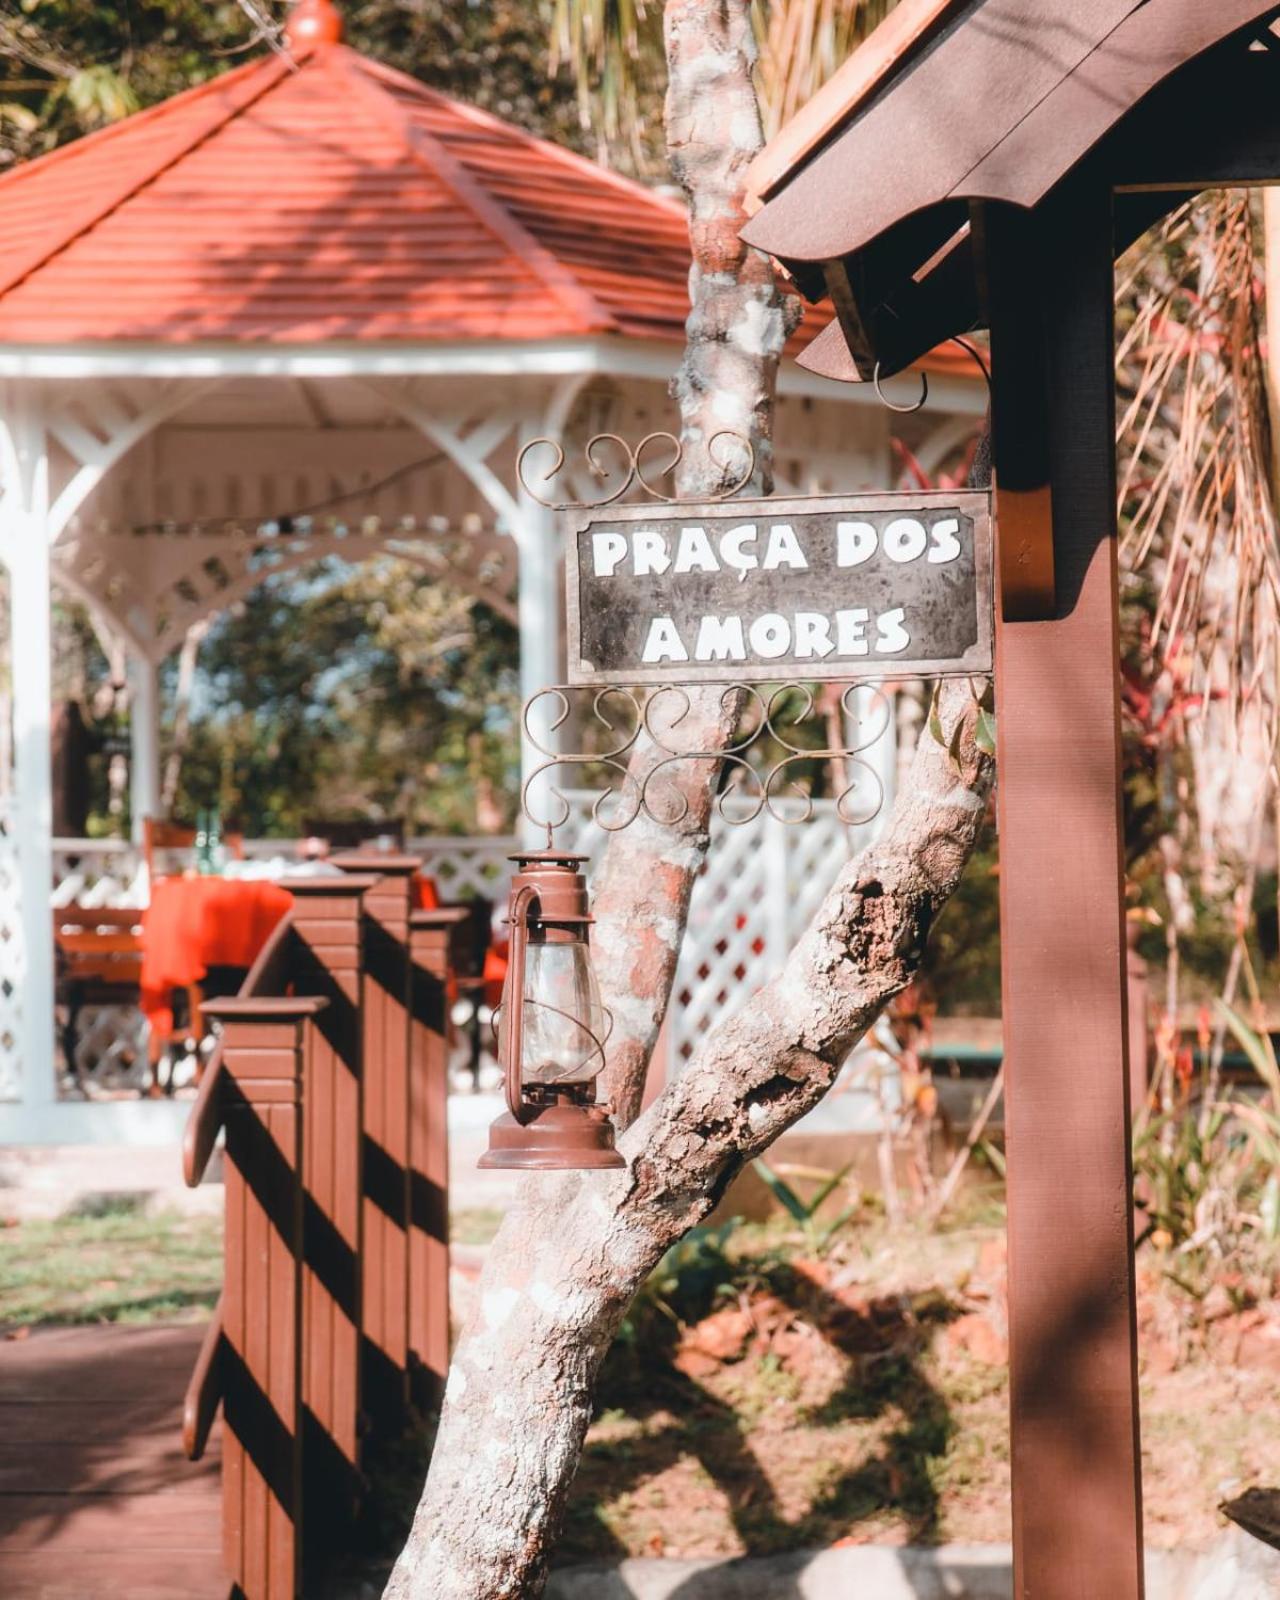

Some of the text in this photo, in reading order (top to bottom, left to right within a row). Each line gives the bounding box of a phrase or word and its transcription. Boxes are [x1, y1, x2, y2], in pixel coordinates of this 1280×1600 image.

[592, 518, 961, 582] PRAÇA DOS
[641, 607, 910, 662] AMORES
